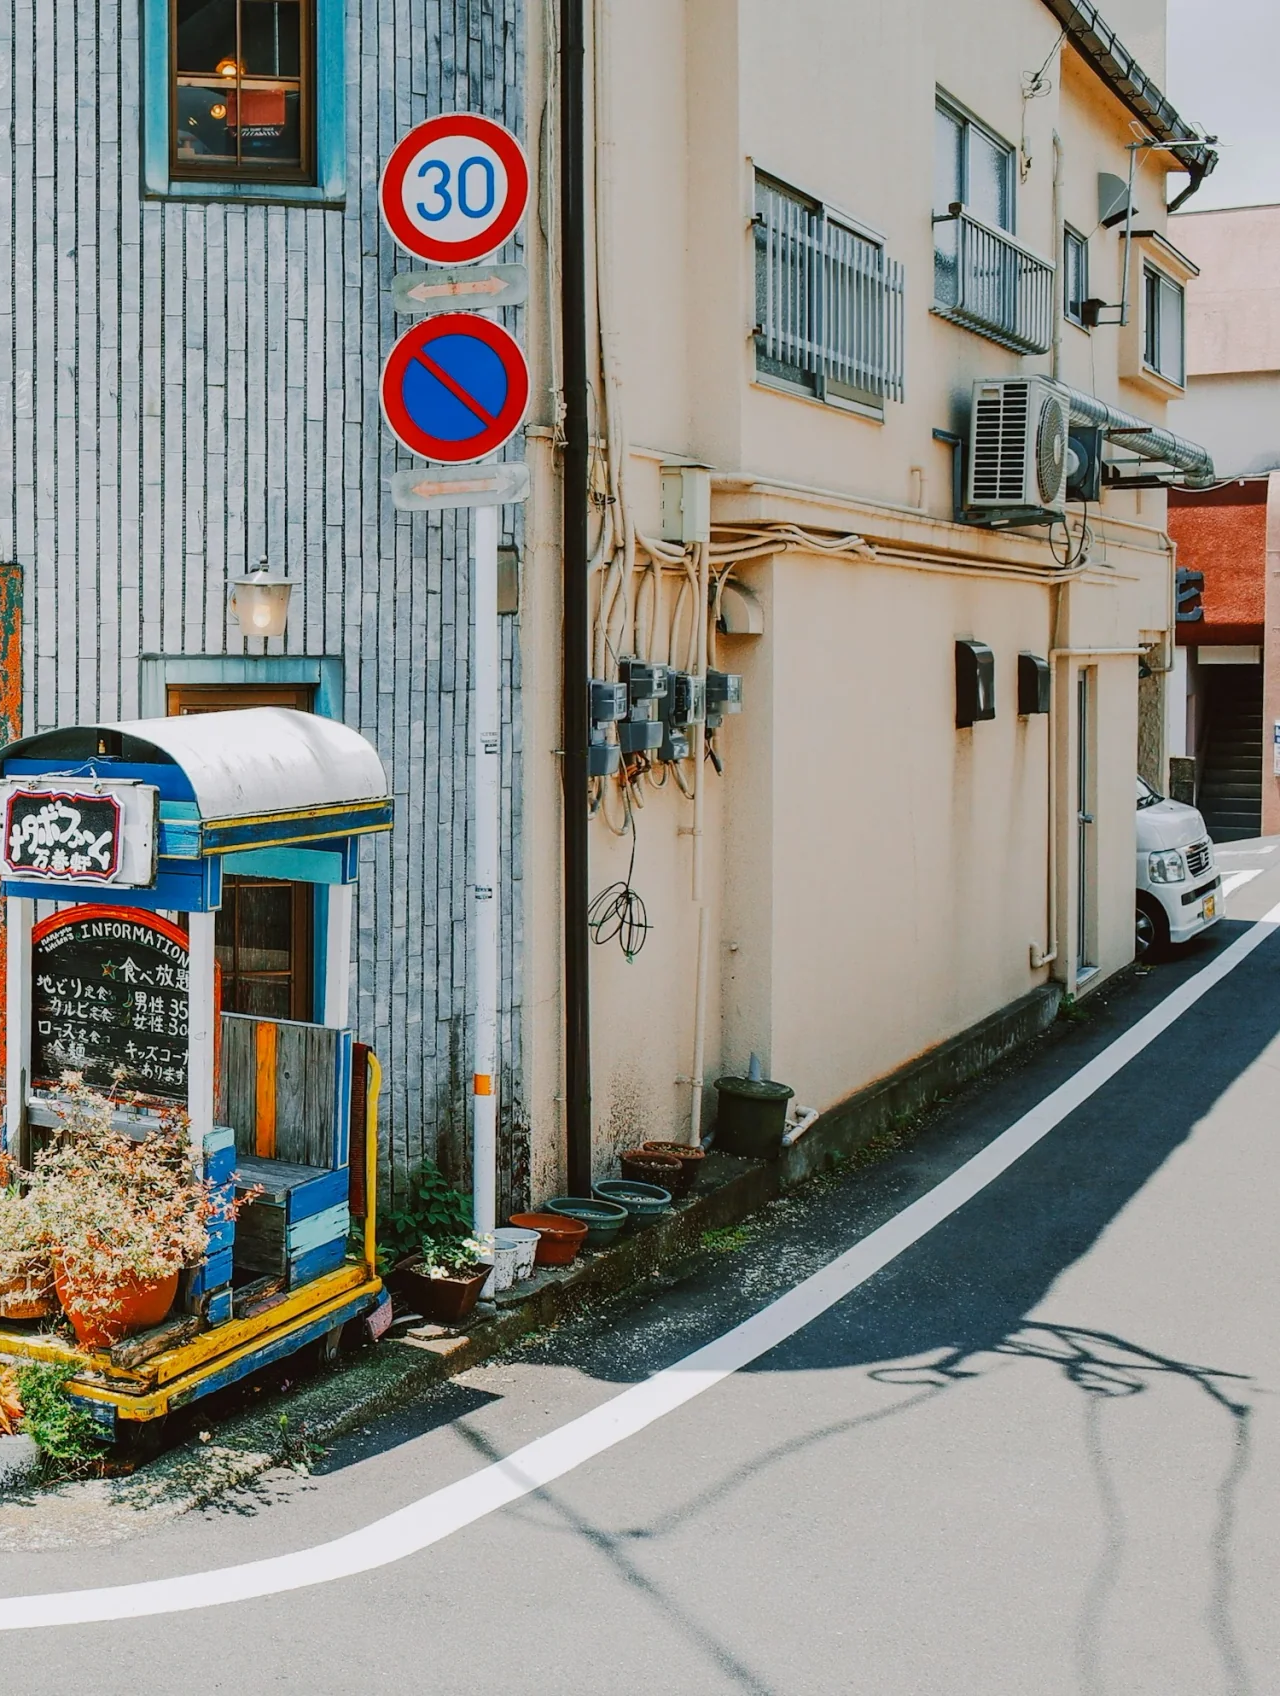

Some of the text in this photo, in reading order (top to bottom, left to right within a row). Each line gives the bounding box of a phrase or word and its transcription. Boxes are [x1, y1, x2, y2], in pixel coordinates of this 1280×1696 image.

[417, 156, 495, 221] 30
[81, 923, 189, 968] INFORMATION
[134, 991, 165, 1016] 男性
[132, 1012, 165, 1034] 女性
[141, 1063, 186, 1085] あります
